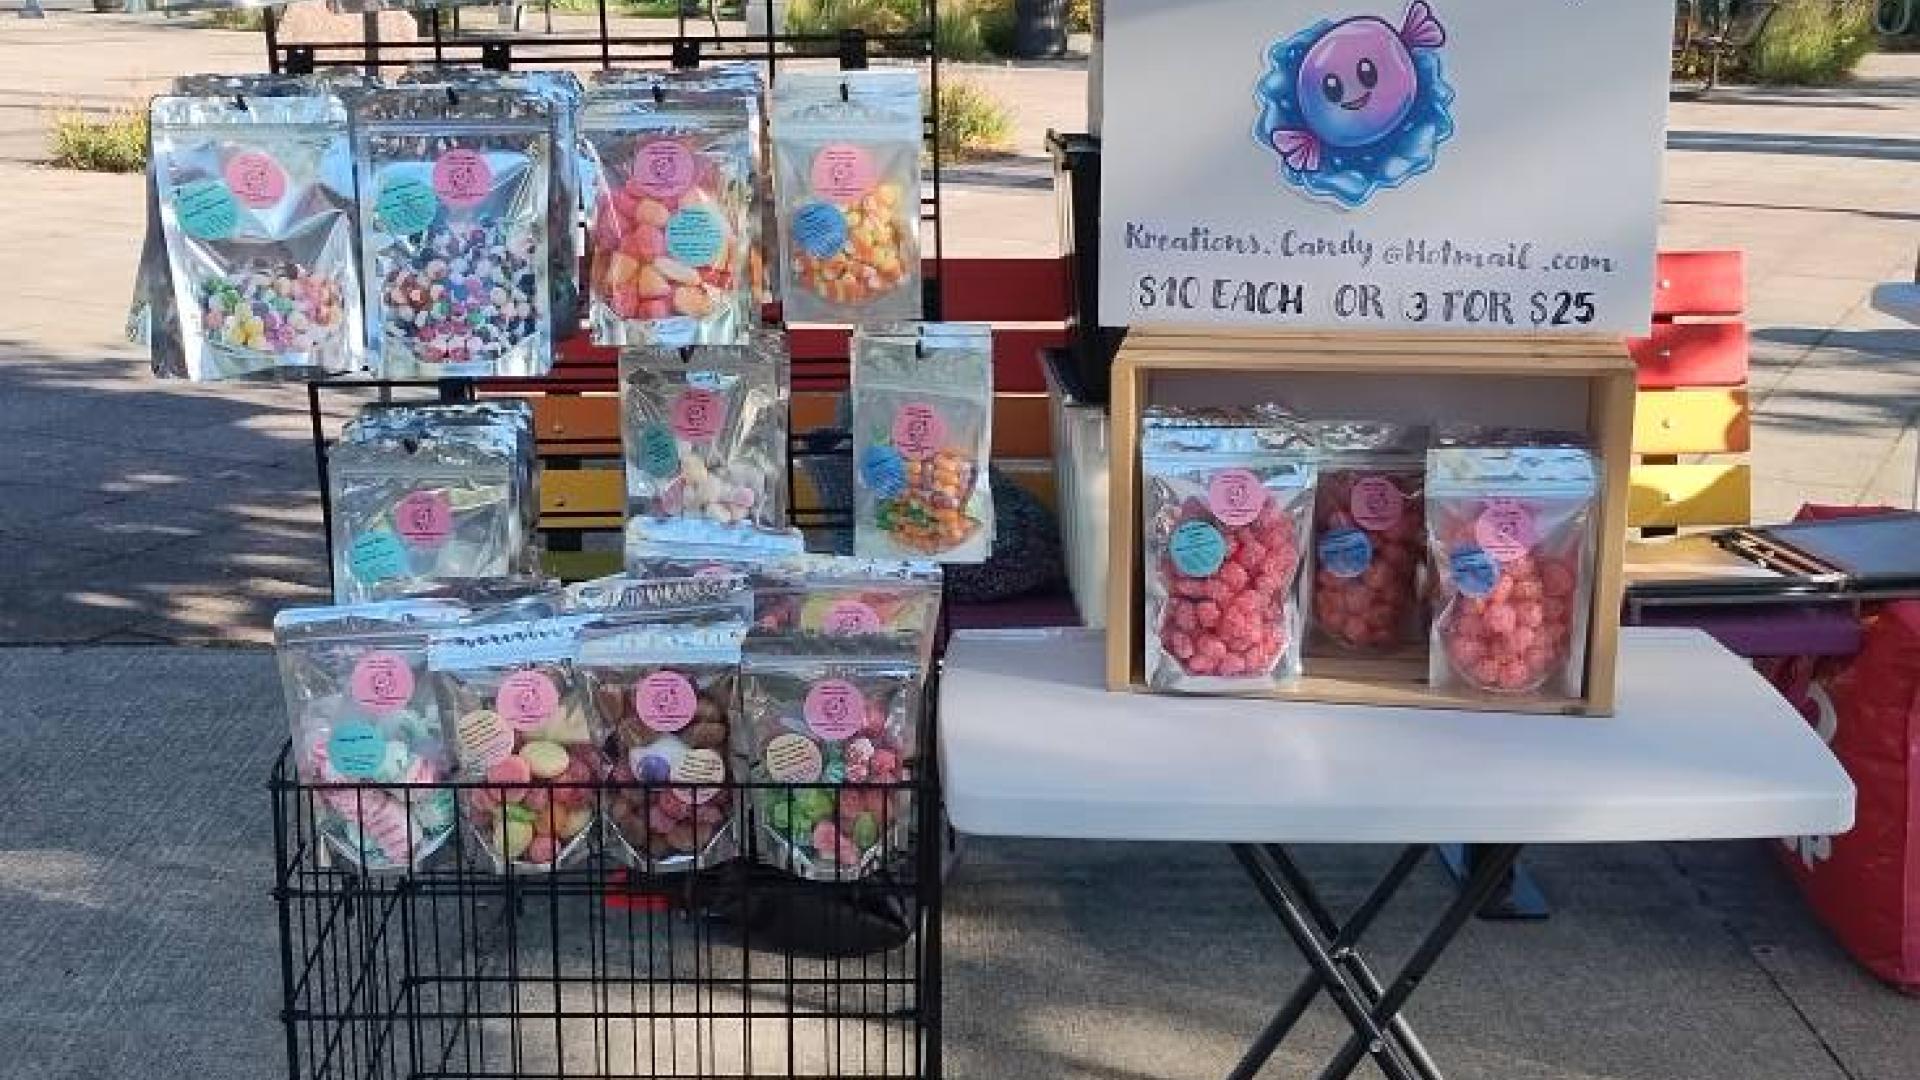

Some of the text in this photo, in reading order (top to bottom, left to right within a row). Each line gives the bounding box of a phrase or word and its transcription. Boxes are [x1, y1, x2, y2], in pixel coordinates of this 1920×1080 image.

[1139, 275, 1595, 325] $10 EACH OR 3 FOR $25
